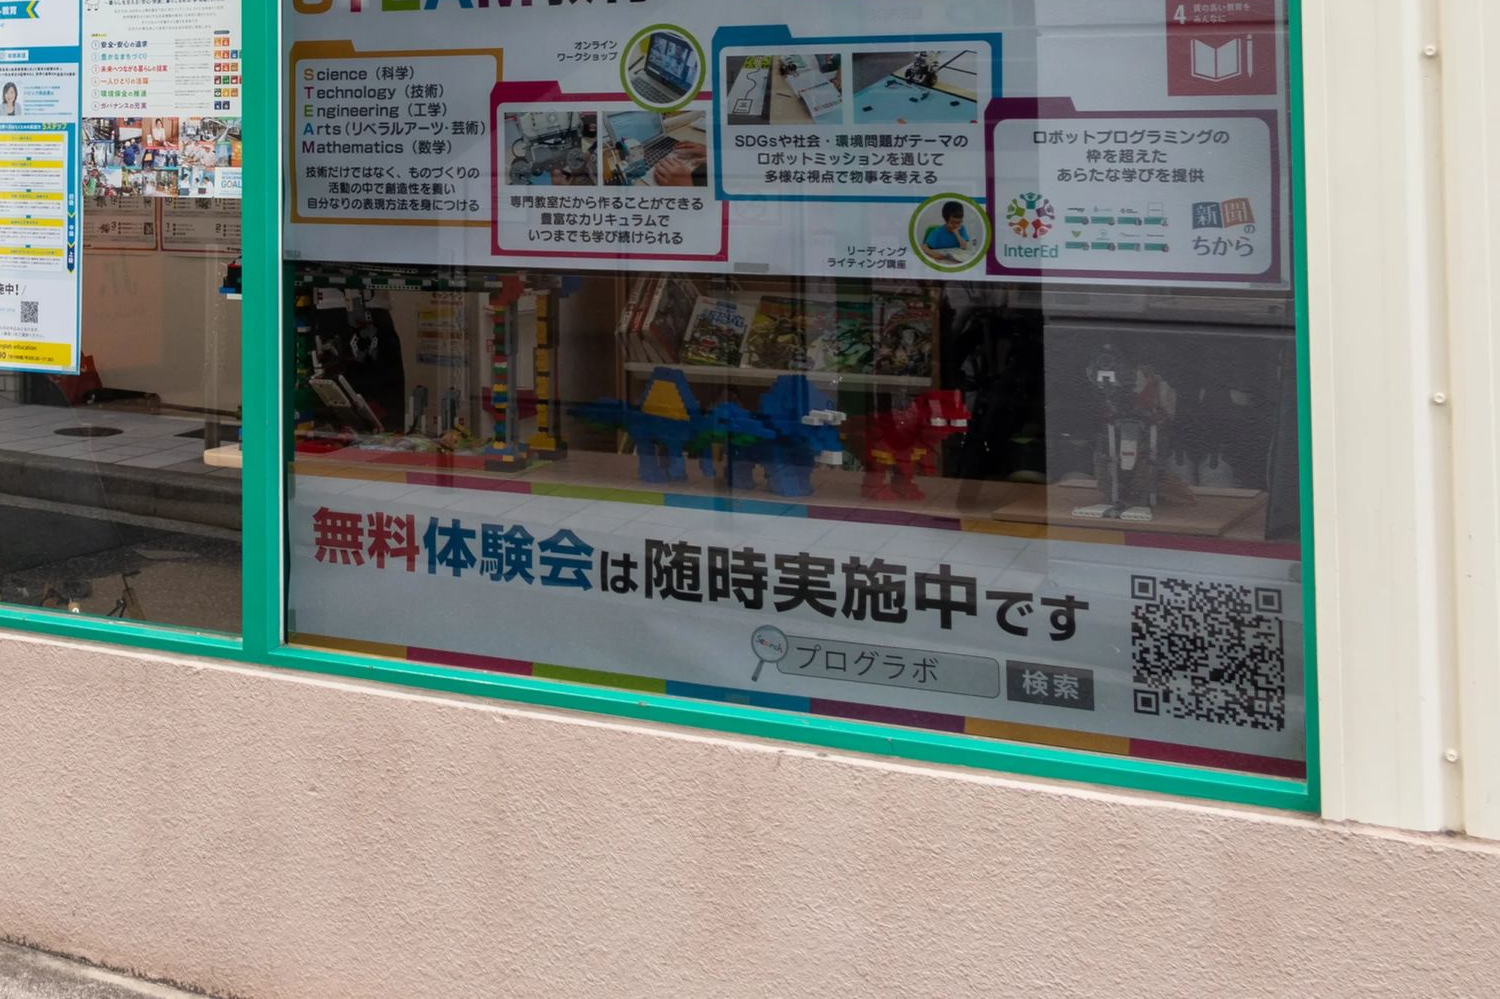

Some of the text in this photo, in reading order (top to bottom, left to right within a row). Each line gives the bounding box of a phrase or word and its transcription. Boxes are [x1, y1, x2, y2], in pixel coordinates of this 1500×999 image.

[1173, 5, 1187, 24] 4
[1193, 2, 1250, 13] 質の高い教育を
[1193, 13, 1226, 23] みんなに
[574, 40, 617, 51] オンライン
[556, 51, 618, 63] ワークショップ
[303, 67, 367, 81] Science
[304, 84, 396, 100] Technology
[303, 103, 399, 119] Engineering
[735, 133, 969, 149] SDGsや社会・環境問題がテーマの
[1033, 129, 1230, 145] ロボットプログラミングの
[302, 140, 404, 154] Mathematics
[757, 152, 945, 167] ロボットミッションを通じて
[1086, 149, 1168, 164] 枠を超えた
[305, 166, 480, 180] 技術だけではなく、ものづくりの
[765, 170, 938, 185] 多様な視点で物事を考える
[1057, 168, 1205, 184] あらたな学びを提供
[221, 180, 242, 189] GOAL
[328, 182, 455, 196] 活動の中で創造性を養い
[307, 198, 480, 212] 自分なりの表現方法を身につける
[509, 195, 704, 211] 専門教室だから作ることができる
[540, 211, 670, 227] 豊富なカリキュラムで
[1195, 201, 1251, 226] 新聞
[528, 228, 683, 245] いつまでも学び続けられる
[846, 245, 908, 257] リーディング
[1004, 245, 1059, 259] InterEd
[1192, 236, 1255, 258] ちから
[827, 257, 907, 270] ライティング講座
[312, 506, 1090, 642] 無料体験会は随時実施中です
[795, 644, 1080, 701] プログラボ 検索
